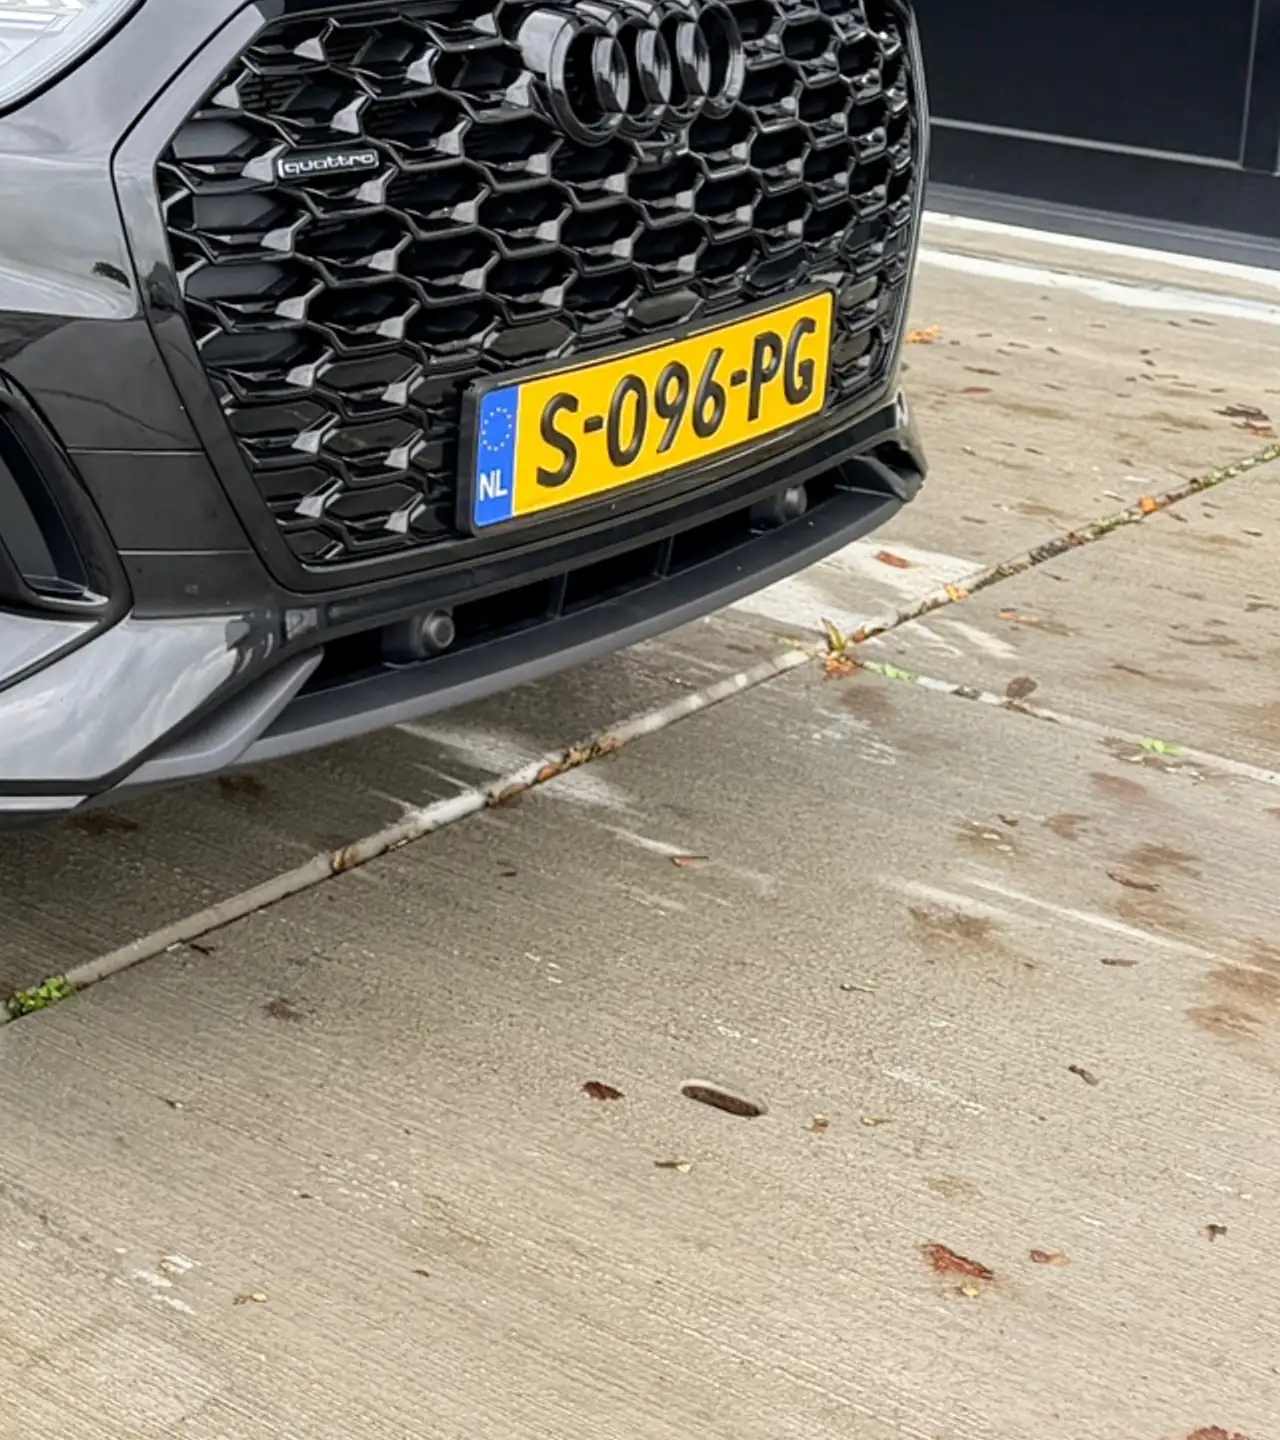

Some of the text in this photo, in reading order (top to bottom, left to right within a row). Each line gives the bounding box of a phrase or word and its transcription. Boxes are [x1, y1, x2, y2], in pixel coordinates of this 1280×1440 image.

[284, 153, 375, 174] quattro
[536, 316, 817, 488] S-096-PG
[479, 468, 508, 502] NL
